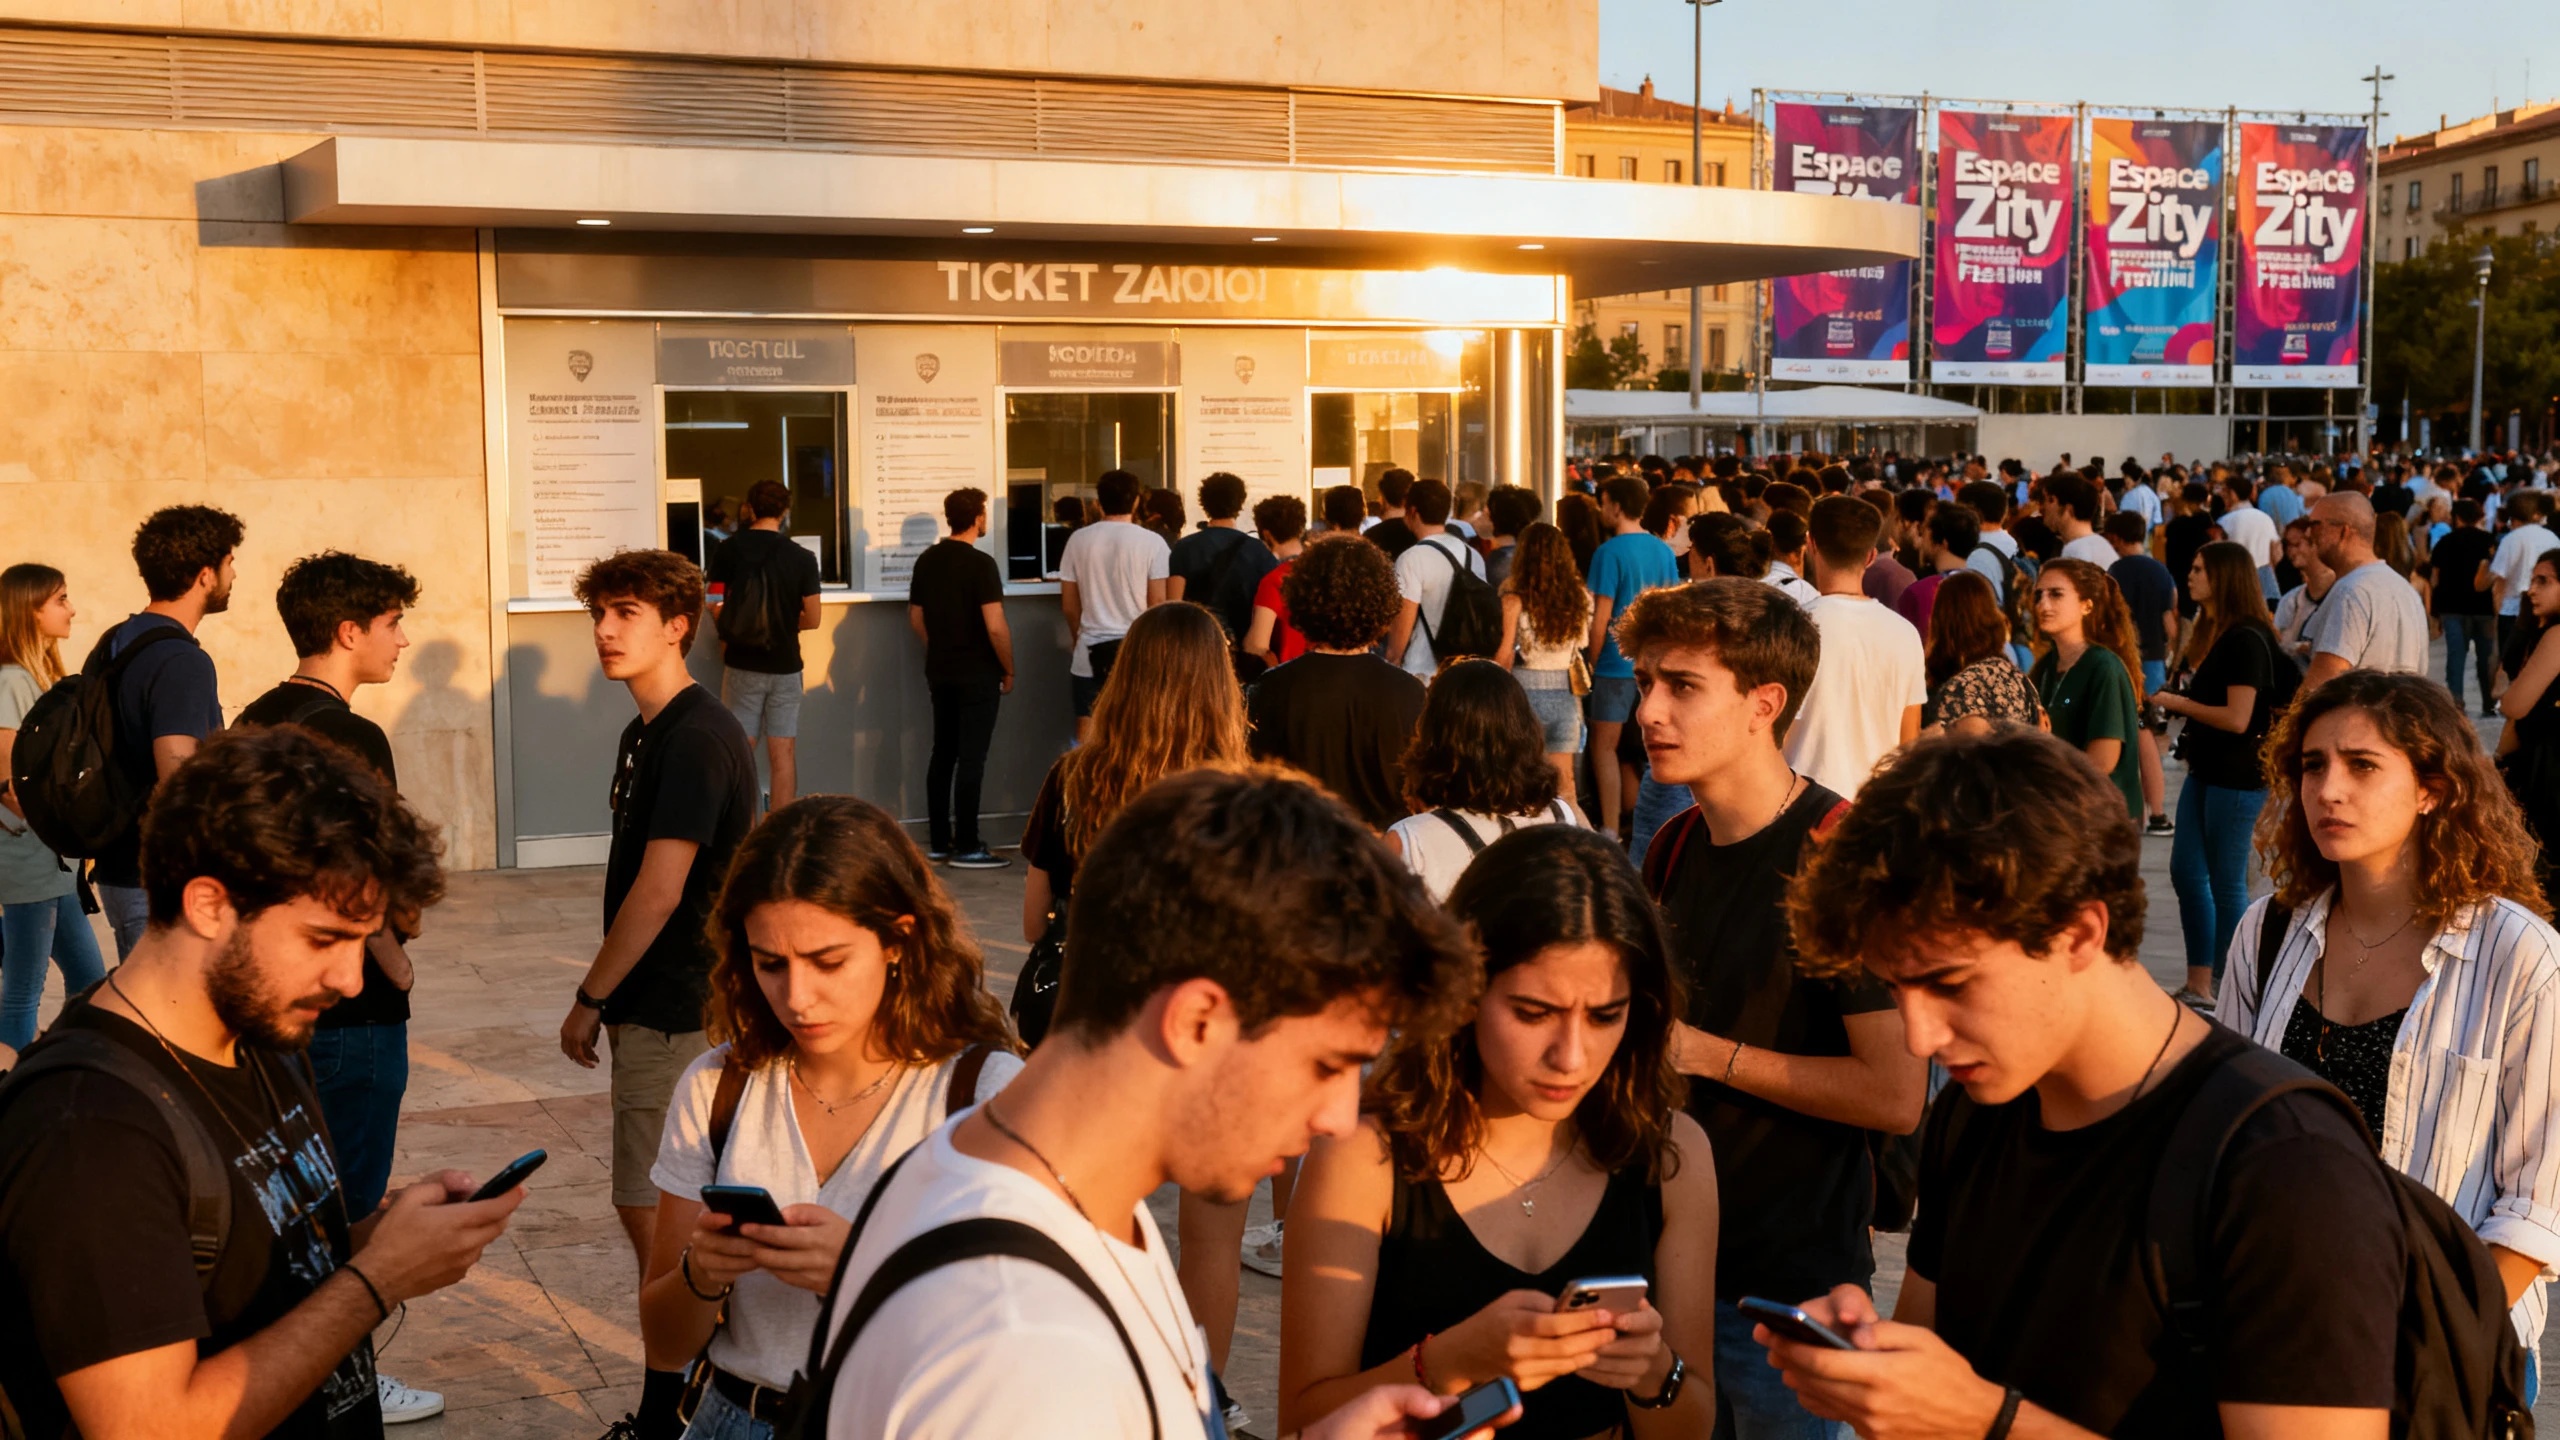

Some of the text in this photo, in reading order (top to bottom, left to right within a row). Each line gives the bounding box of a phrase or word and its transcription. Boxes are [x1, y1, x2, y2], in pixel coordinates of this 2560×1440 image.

[1792, 144, 1902, 182] Espace
[1955, 151, 2060, 186] Espace
[2109, 158, 2210, 193] Espace
[2256, 162, 2356, 195] Espace
[1954, 185, 2063, 255] Zity
[2108, 191, 2213, 258] Zity
[2254, 194, 2358, 262] Zity
[937, 261, 1098, 302] TICKET
